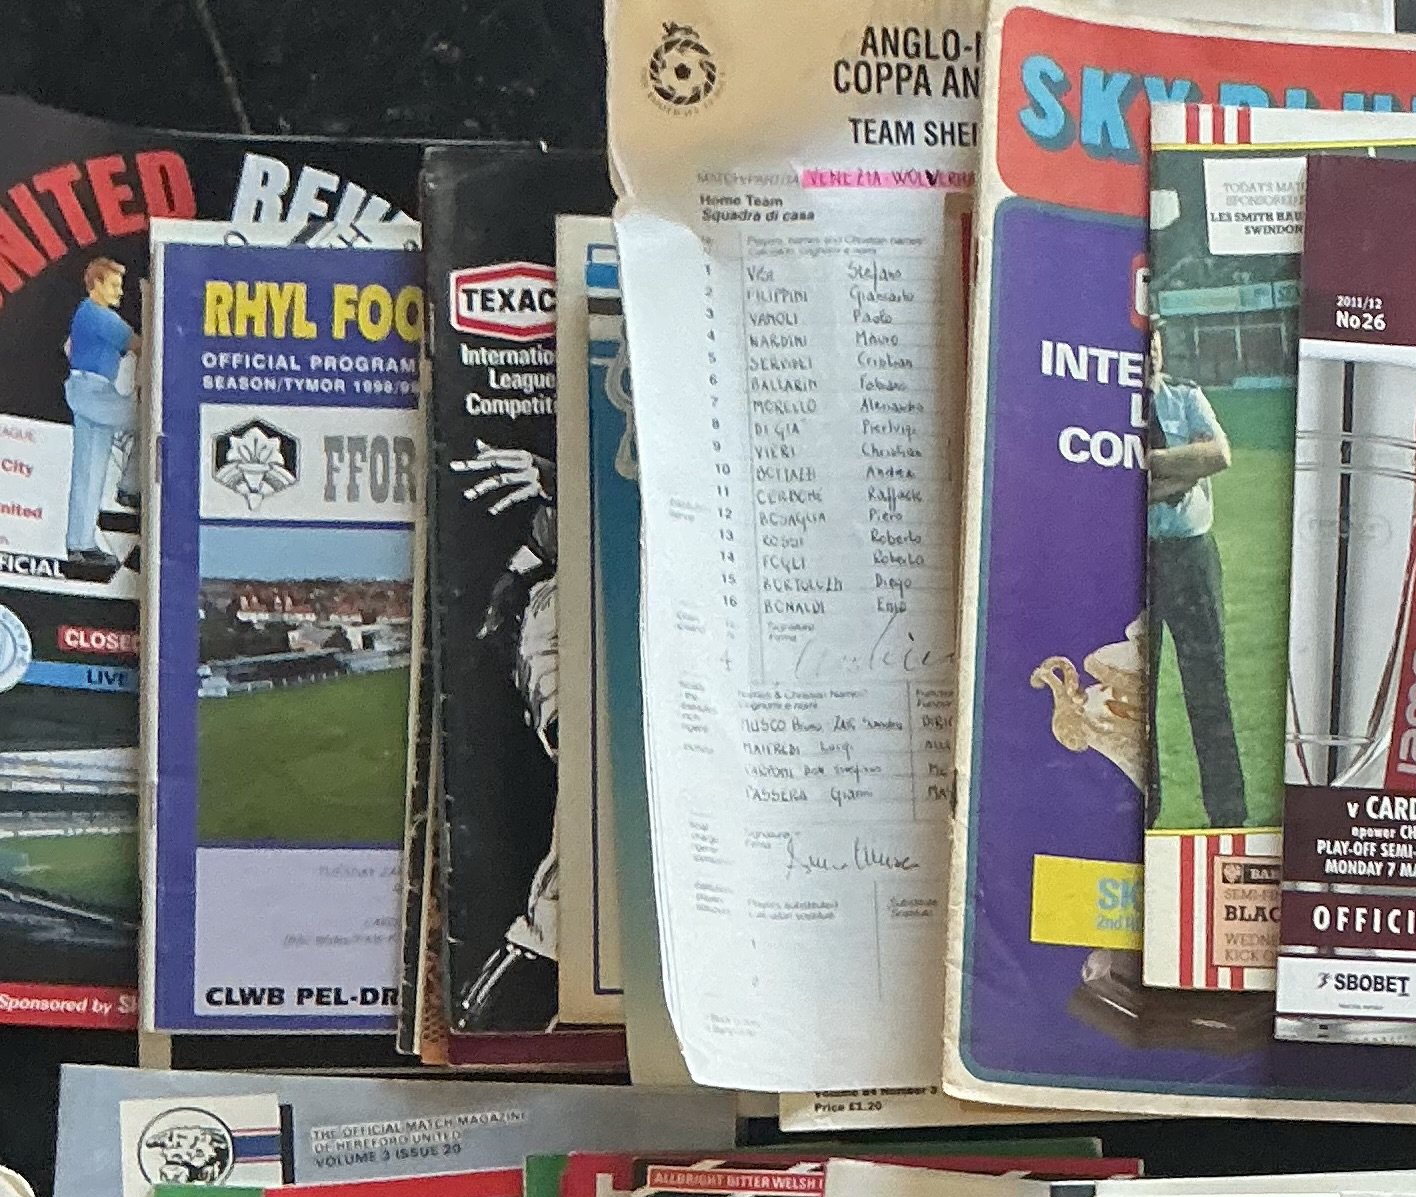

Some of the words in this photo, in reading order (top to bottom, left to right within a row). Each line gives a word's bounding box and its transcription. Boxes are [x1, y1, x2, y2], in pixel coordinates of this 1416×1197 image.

[834, 59, 931, 98] COPPA
[848, 118, 915, 145] TEAM
[700, 195, 741, 207] Home
[746, 195, 783, 208] Team
[702, 208, 761, 222] Squadra
[781, 211, 815, 221] casa
[1234, 212, 1274, 222] SMITH
[1244, 224, 1303, 235] SWINDON
[204, 280, 317, 339] RHYL
[1336, 295, 1383, 310] 2011/12
[1335, 310, 1387, 332] No26
[201, 351, 301, 371] OFFICIAL
[202, 375, 346, 393] SEASON/TYMOR
[323, 434, 416, 503] FFOR
[1346, 802, 1360, 819] v
[1351, 826, 1396, 839] npower
[1316, 840, 1376, 858] PLAY-OFF
[1325, 859, 1383, 877] MONDAY
[1333, 973, 1410, 997] SBOBET
[92, 994, 112, 1016] by
[206, 986, 286, 1007] CLWB
[311, 1126, 339, 1142] THE
[341, 1120, 402, 1139] OFFICIAL
[406, 1116, 453, 1134] MATCH
[456, 1110, 529, 1129] MAGAZINE
[335, 1135, 408, 1152] HEREFORD
[413, 1129, 464, 1147] UNITED
[314, 1151, 379, 1169] VOLUME
[395, 1145, 440, 1162] ISSUE
[443, 1142, 463, 1158] 20
[652, 1171, 726, 1189] ALLBRIGHT
[727, 1173, 771, 1191] BITTER
[771, 1175, 818, 1192] WELSH
